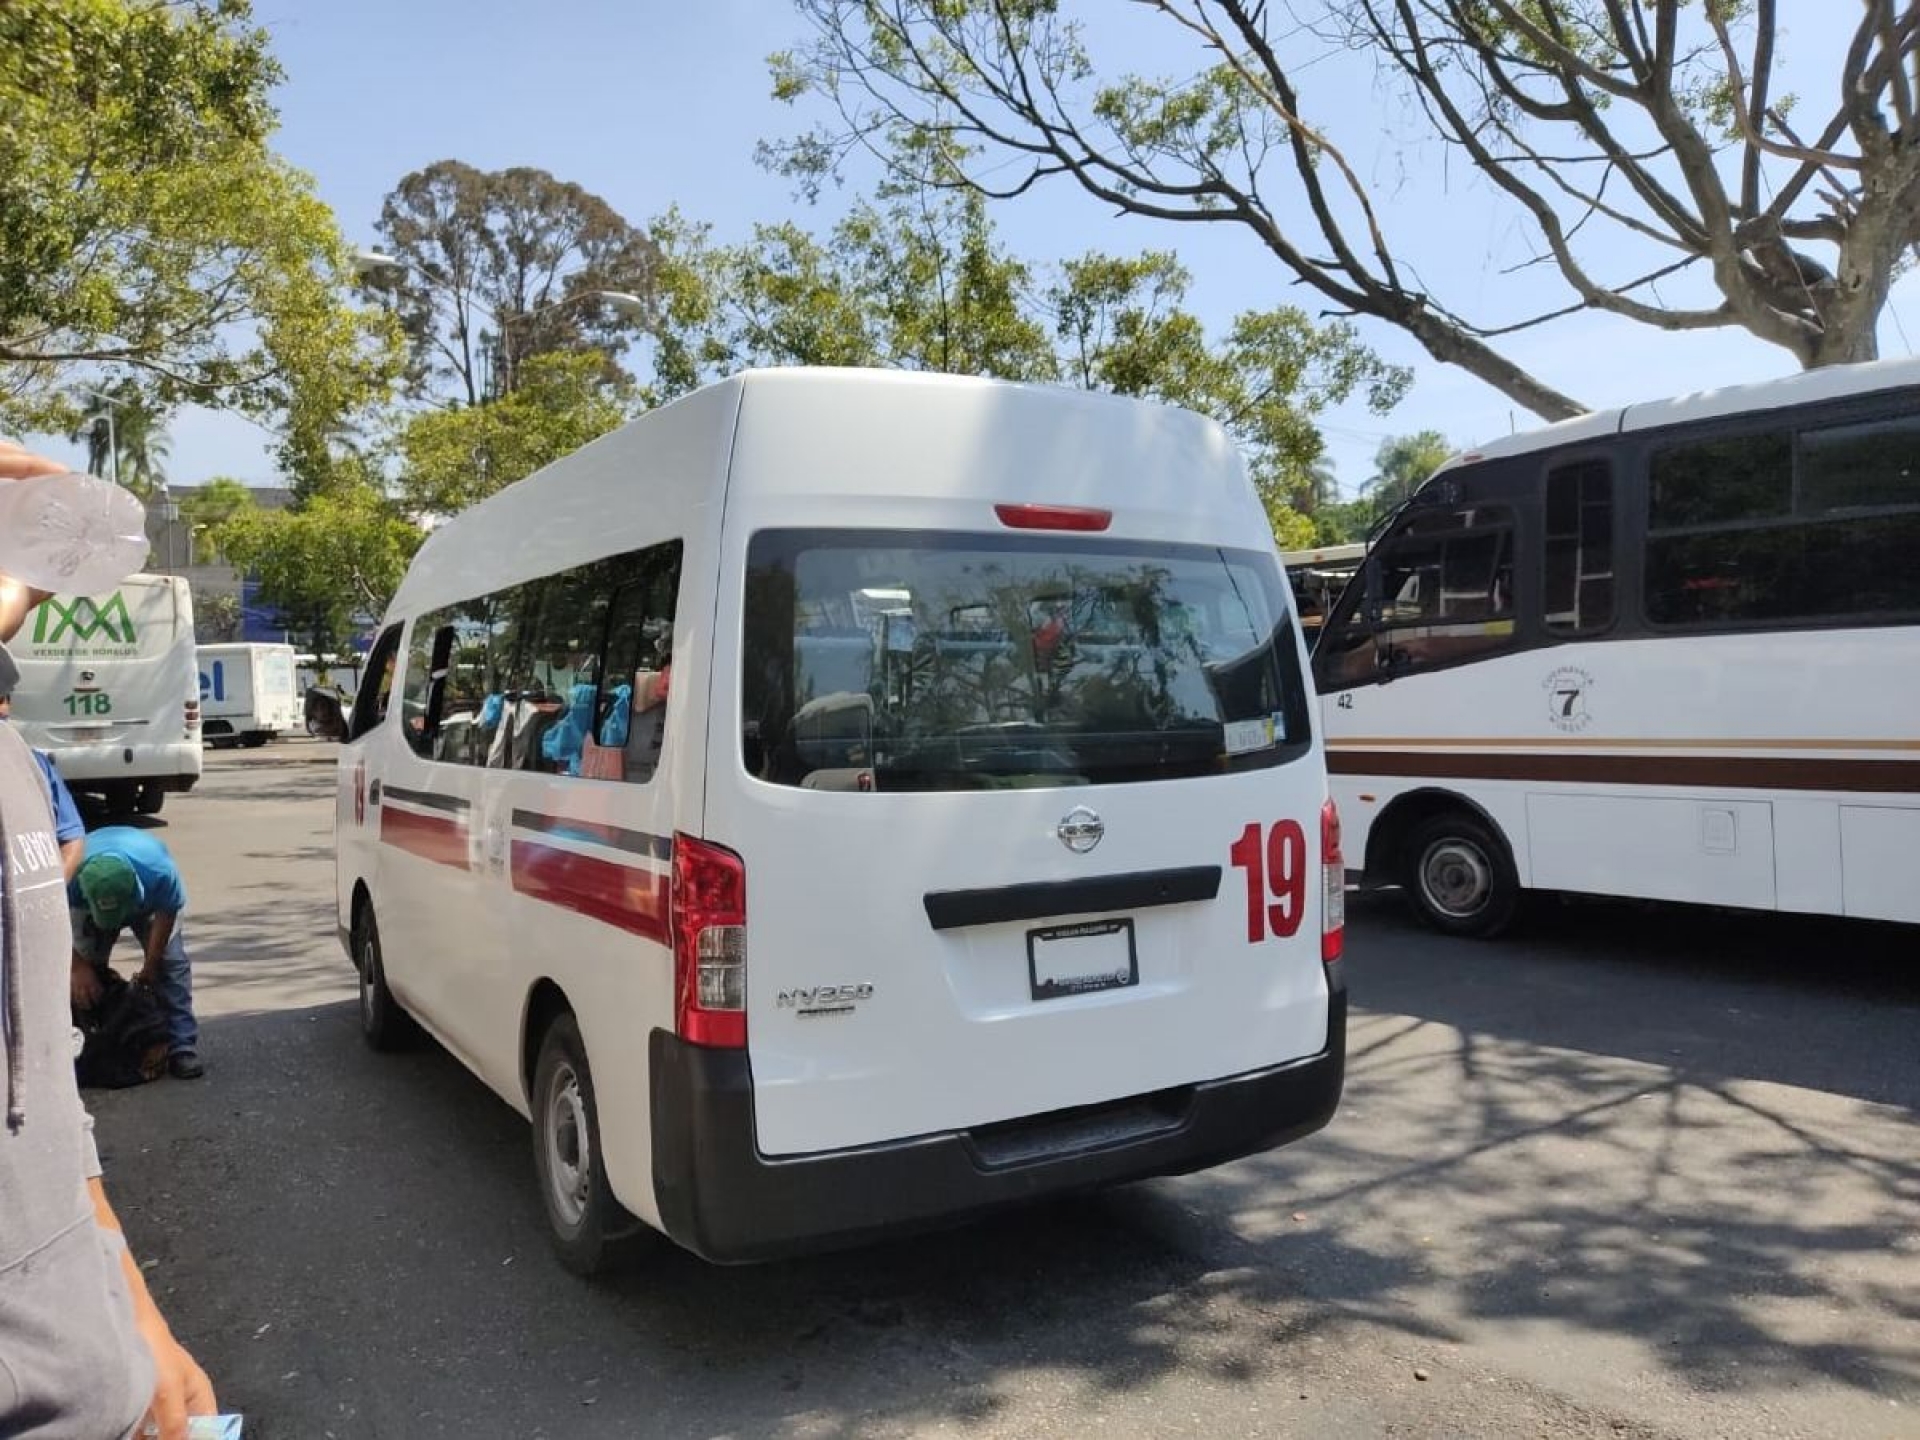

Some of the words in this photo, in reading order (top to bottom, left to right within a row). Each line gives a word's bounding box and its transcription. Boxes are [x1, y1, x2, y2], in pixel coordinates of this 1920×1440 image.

[63, 692, 112, 716] 118
[1337, 693, 1354, 710] 42
[1556, 689, 1580, 717] 7
[1230, 818, 1307, 943] 19
[776, 982, 874, 1008] NV350
